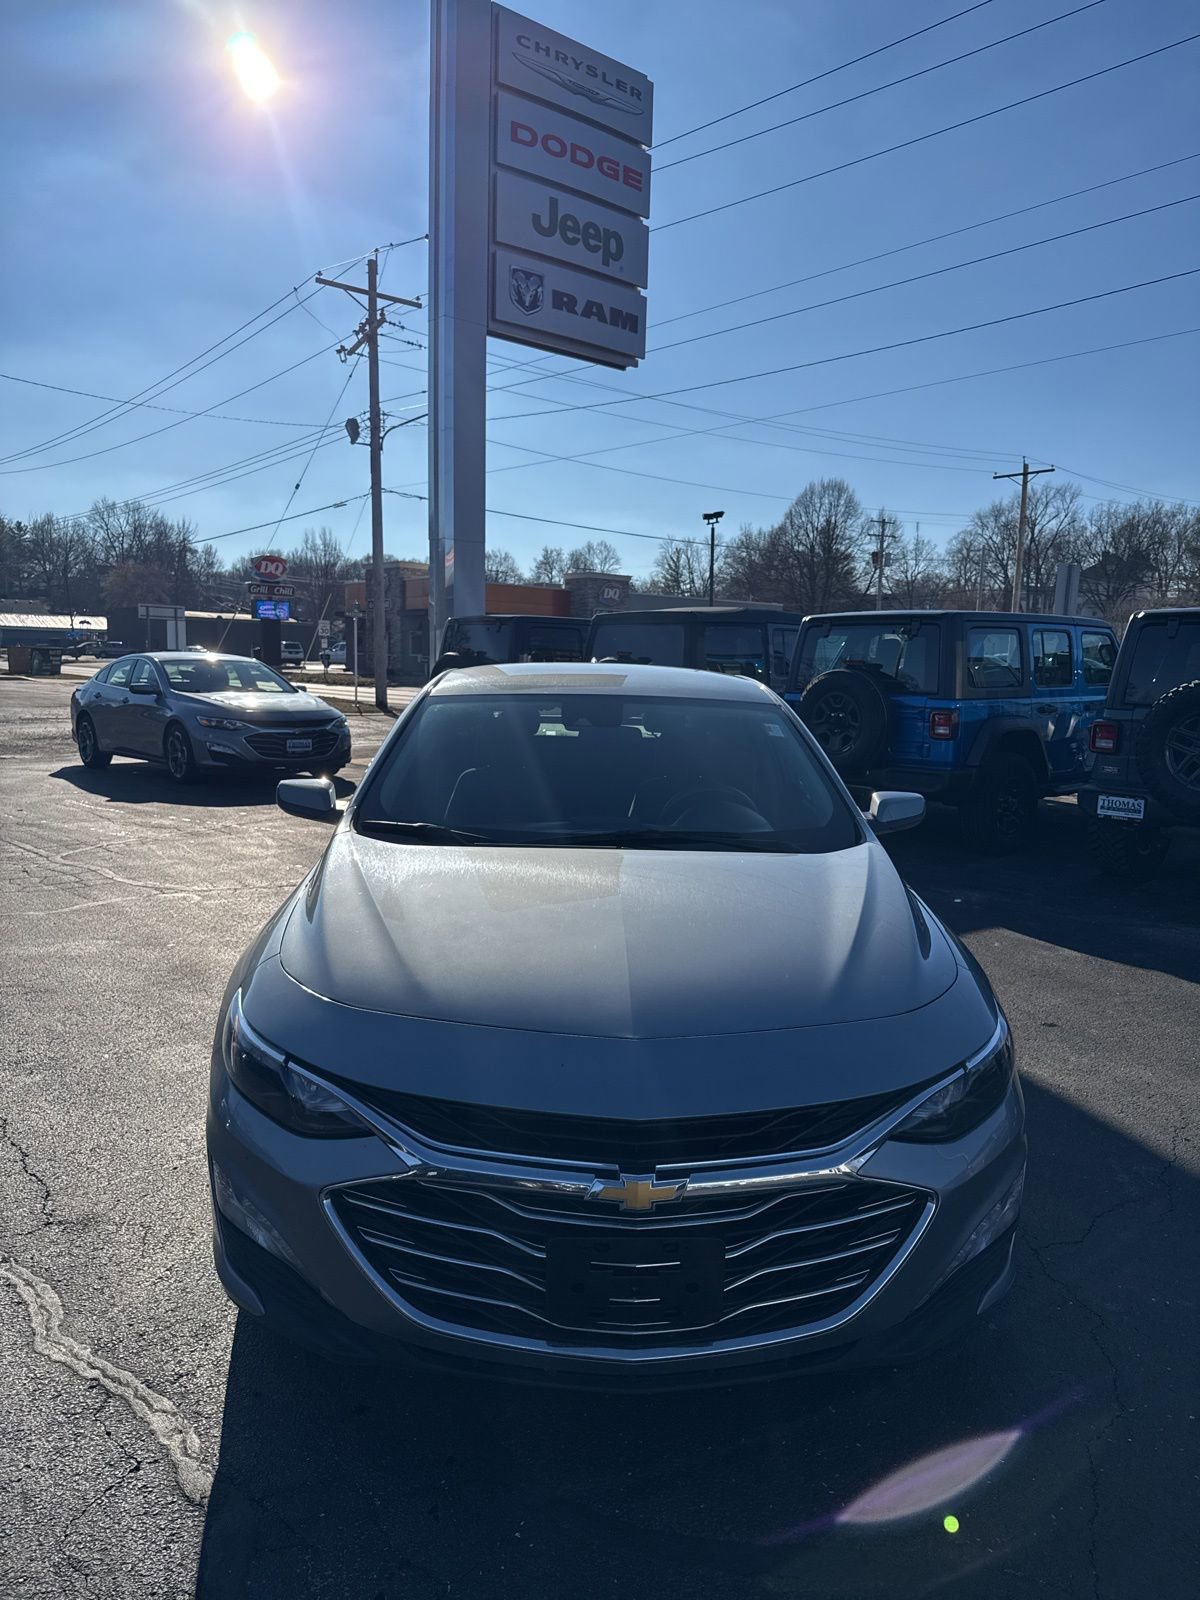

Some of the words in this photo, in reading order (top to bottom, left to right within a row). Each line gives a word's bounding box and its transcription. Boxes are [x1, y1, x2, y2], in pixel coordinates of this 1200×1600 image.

[516, 35, 642, 101] CHRYSLER
[510, 120, 642, 192] DODGE
[532, 197, 624, 268] Jeep
[552, 288, 638, 334] RAM
[260, 560, 284, 577] DQ
[250, 585, 269, 594] Grill
[274, 586, 294, 596] Chill
[603, 588, 620, 601] DQ
[1100, 799, 1142, 810] THOMAS
